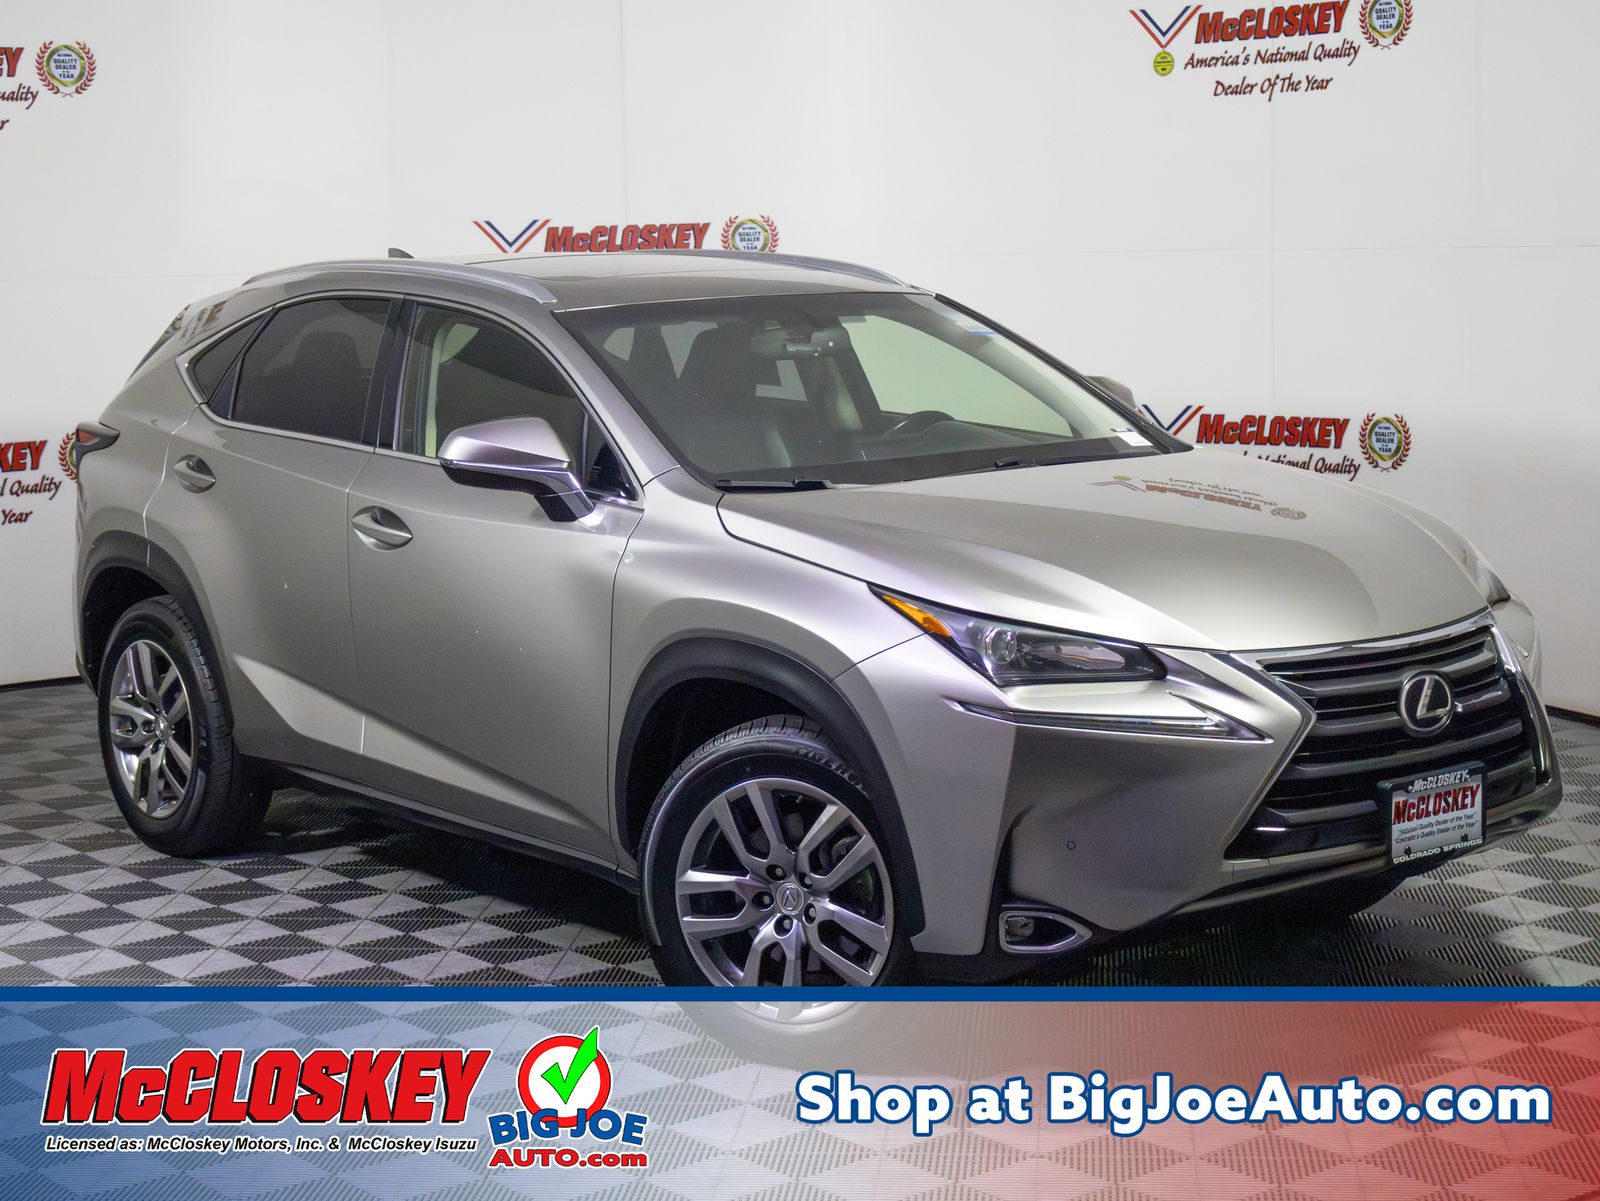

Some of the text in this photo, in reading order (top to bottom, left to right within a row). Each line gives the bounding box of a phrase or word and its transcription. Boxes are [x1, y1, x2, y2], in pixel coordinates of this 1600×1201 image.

[1195, 0, 1350, 44] McCLOSKEY
[1184, 46, 1250, 70] America's
[1254, 41, 1313, 65] National
[1313, 38, 1361, 67] Quality
[0, 83, 39, 110] uality
[1213, 73, 1334, 102] Dealer Of The Year
[544, 222, 711, 253] McCLOSKEY
[1196, 413, 1351, 449] McCLOSKEY
[1314, 457, 1361, 482] Quality
[9, 475, 62, 501] Quality
[1, 509, 34, 526] Year
[1411, 769, 1469, 793] McCLOSKEY
[1393, 784, 1481, 825] McCLOSKEY
[1393, 838, 1483, 864] COLORADO SPRINGS
